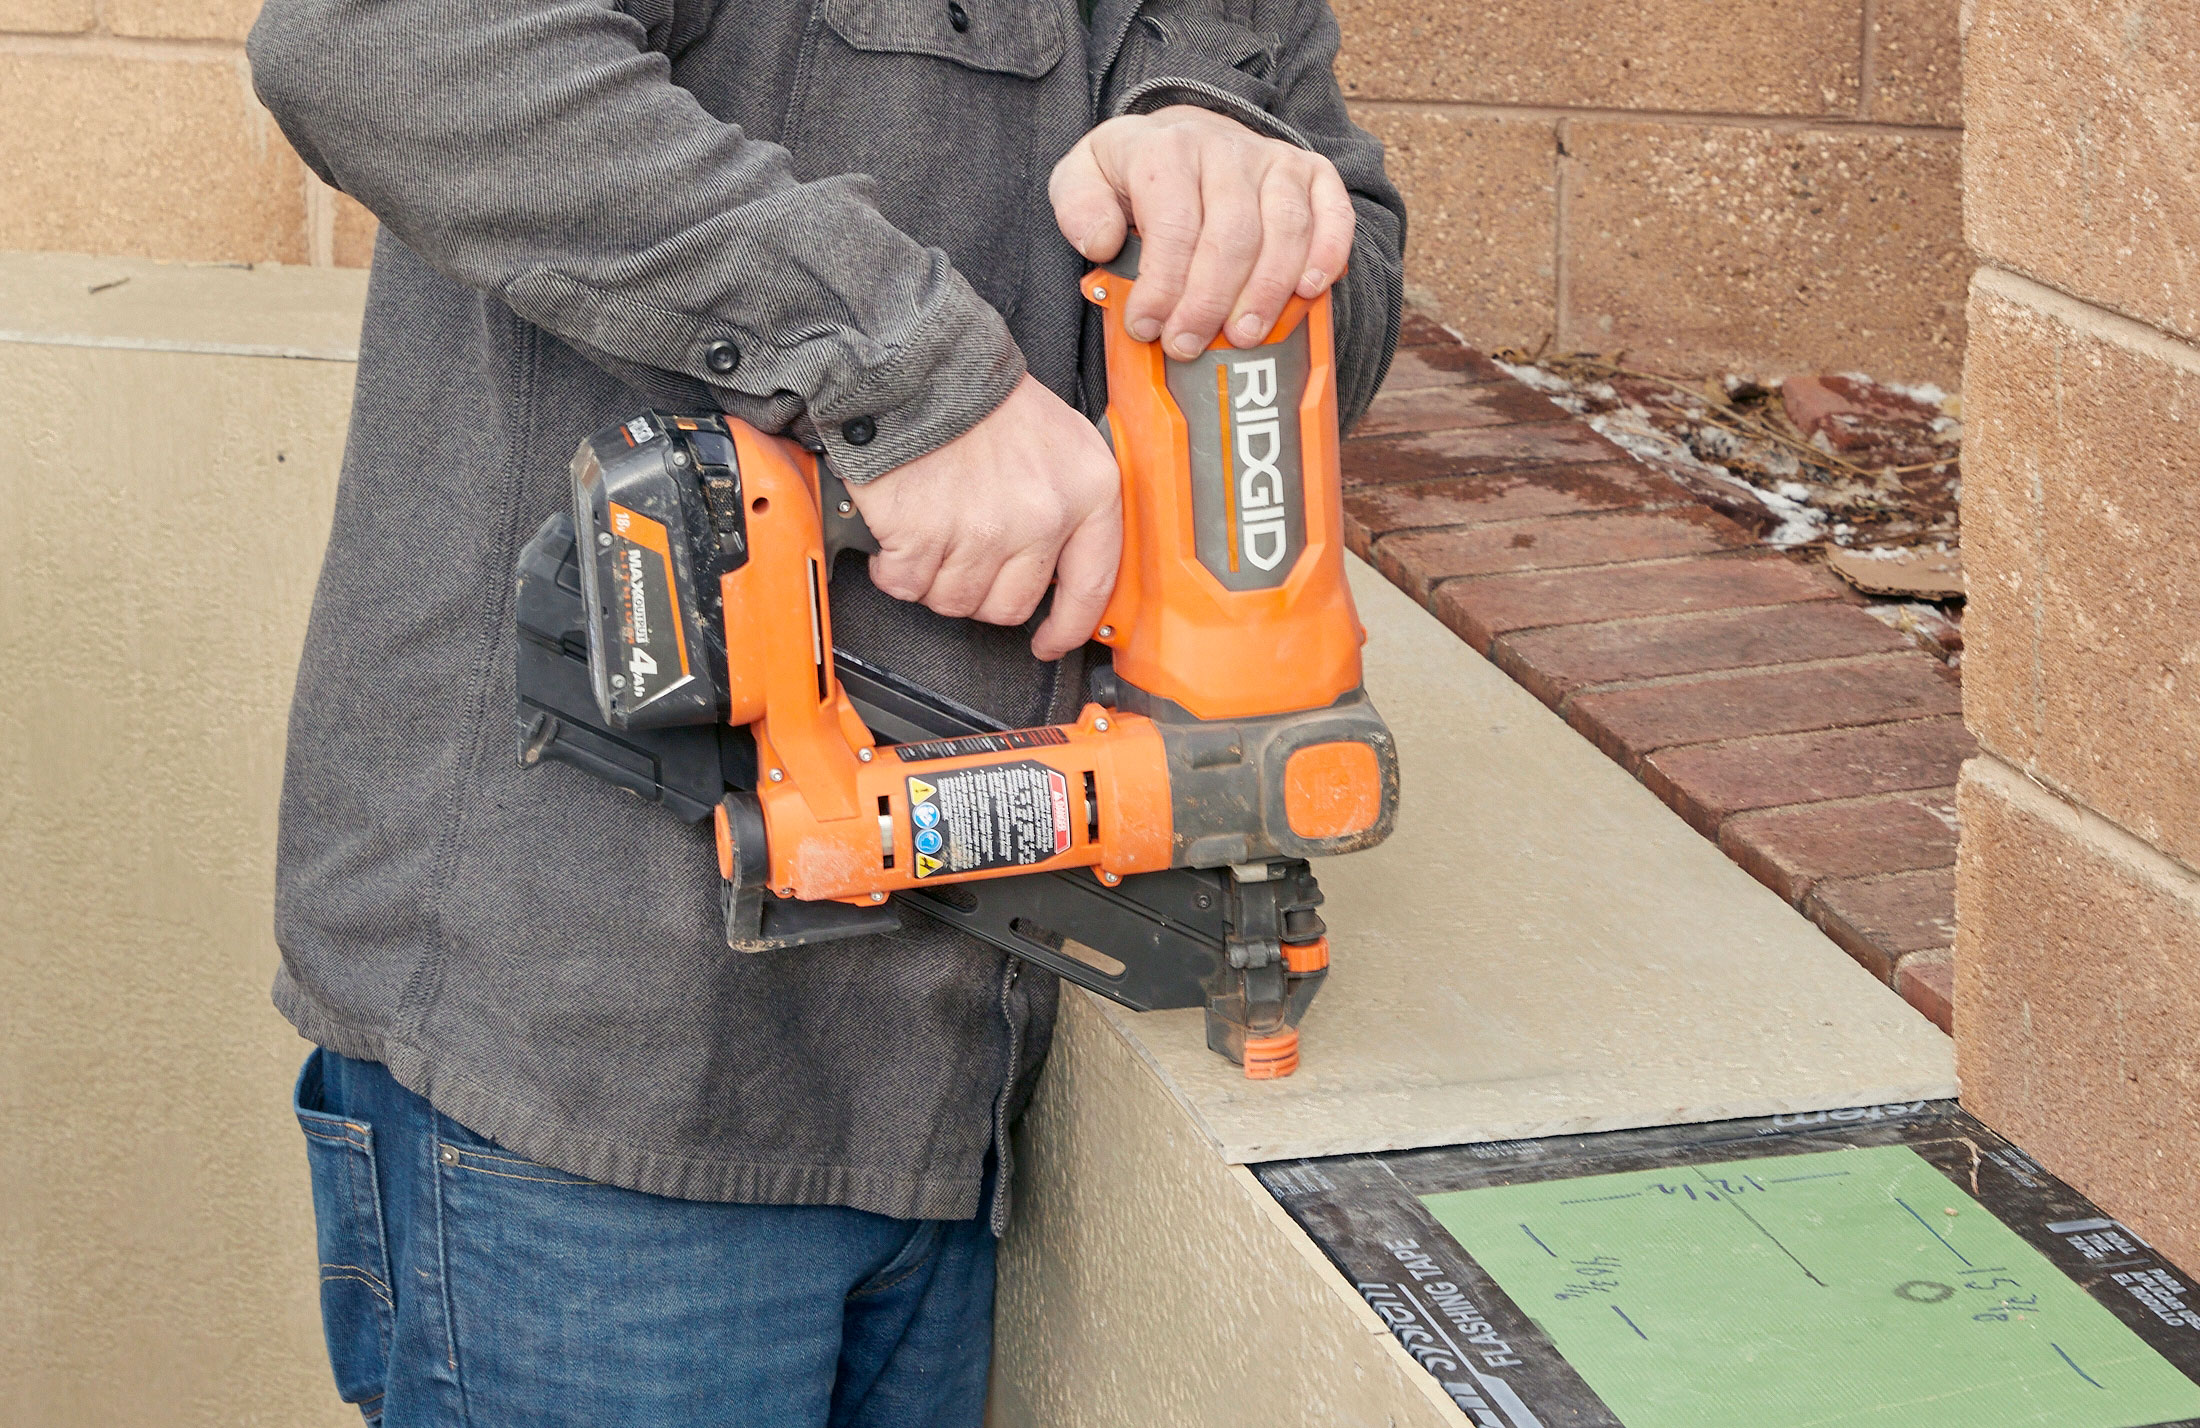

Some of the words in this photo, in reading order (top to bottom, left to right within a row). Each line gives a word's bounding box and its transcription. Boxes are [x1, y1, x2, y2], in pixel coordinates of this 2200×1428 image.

[1233, 357, 1287, 571] RIDGID
[1384, 1238, 1444, 1281] TAPE
[2065, 1235, 2104, 1259] TAPE
[2110, 1272, 2135, 1287] EL
[2126, 1285, 2185, 1327] RODILLO
[2127, 1271, 2187, 1310] APLICAR
[2146, 1268, 2187, 1294] PARA
[1423, 1281, 1523, 1368] FLASHING
